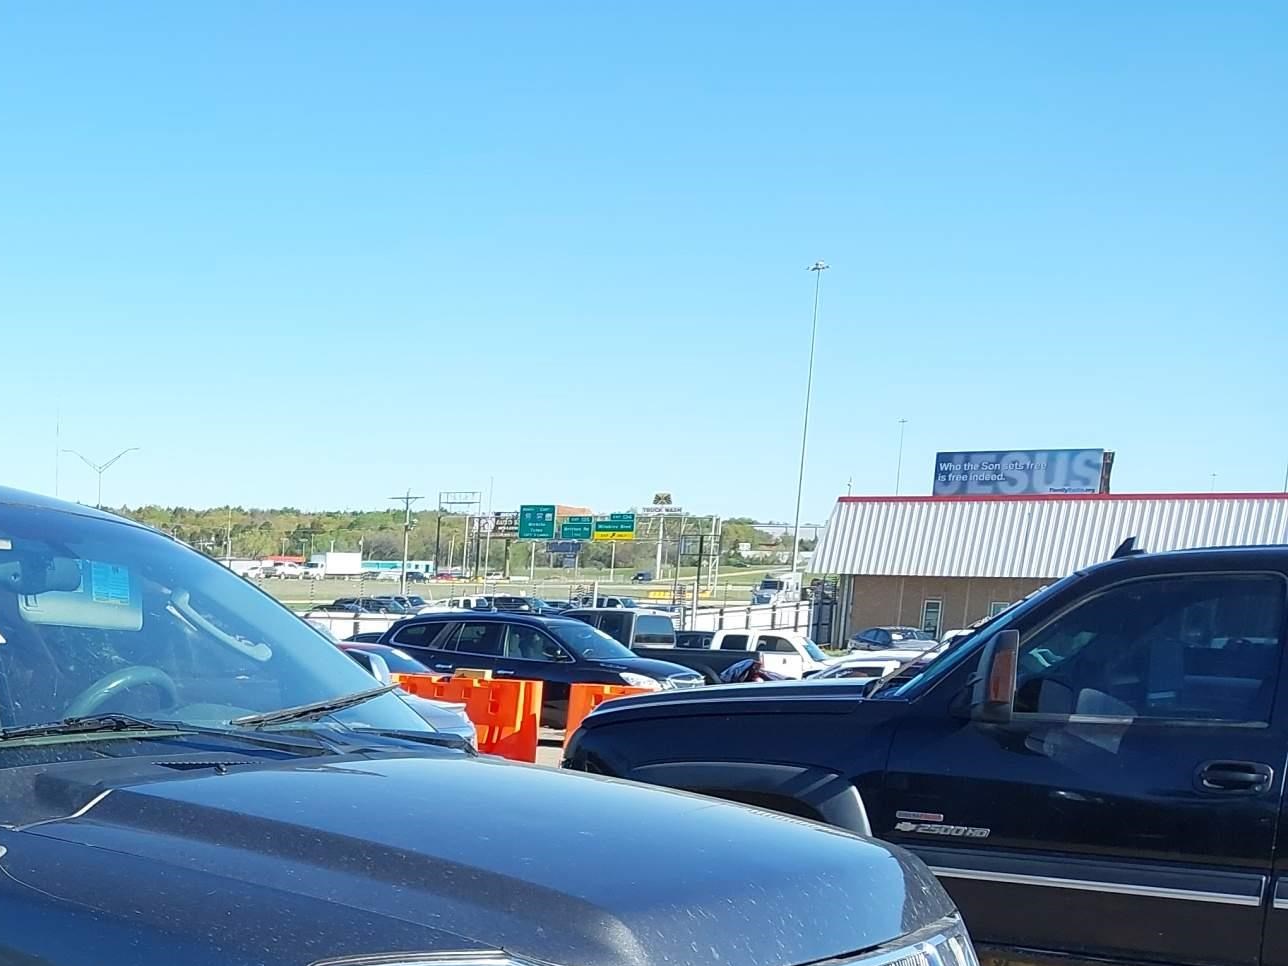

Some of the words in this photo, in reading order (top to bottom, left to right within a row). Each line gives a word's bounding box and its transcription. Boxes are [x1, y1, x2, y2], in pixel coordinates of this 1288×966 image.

[939, 462, 962, 472] Who
[963, 462, 980, 471] the
[981, 461, 1001, 471] Son
[1026, 461, 1047, 471] free
[934, 450, 1100, 495] JESUS
[937, 473, 947, 482] is
[948, 472, 968, 482] free
[969, 472, 1006, 482] indeed.
